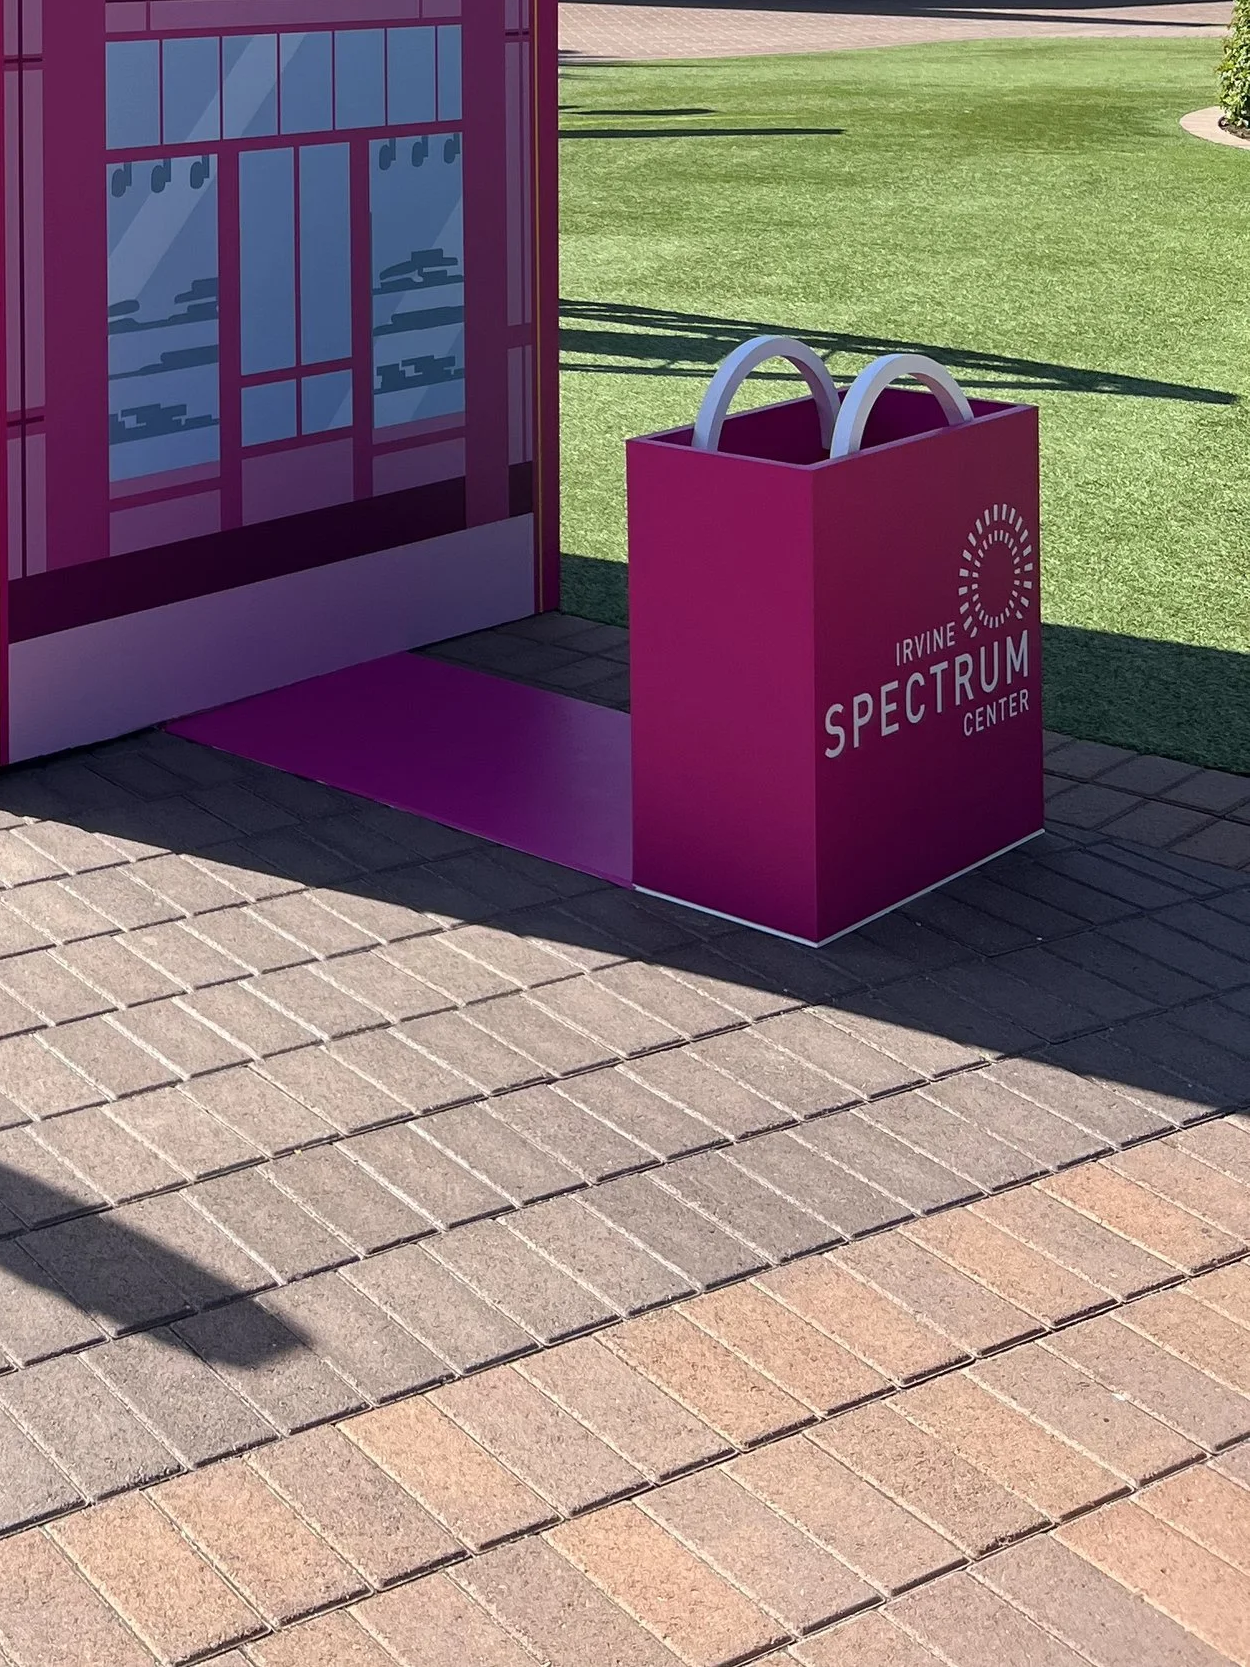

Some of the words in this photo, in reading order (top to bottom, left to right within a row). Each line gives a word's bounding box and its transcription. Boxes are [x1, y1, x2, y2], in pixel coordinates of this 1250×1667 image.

[896, 622, 956, 666] IRVINE
[824, 630, 1029, 759] SPECTRUM
[963, 689, 1030, 736] CENTER
